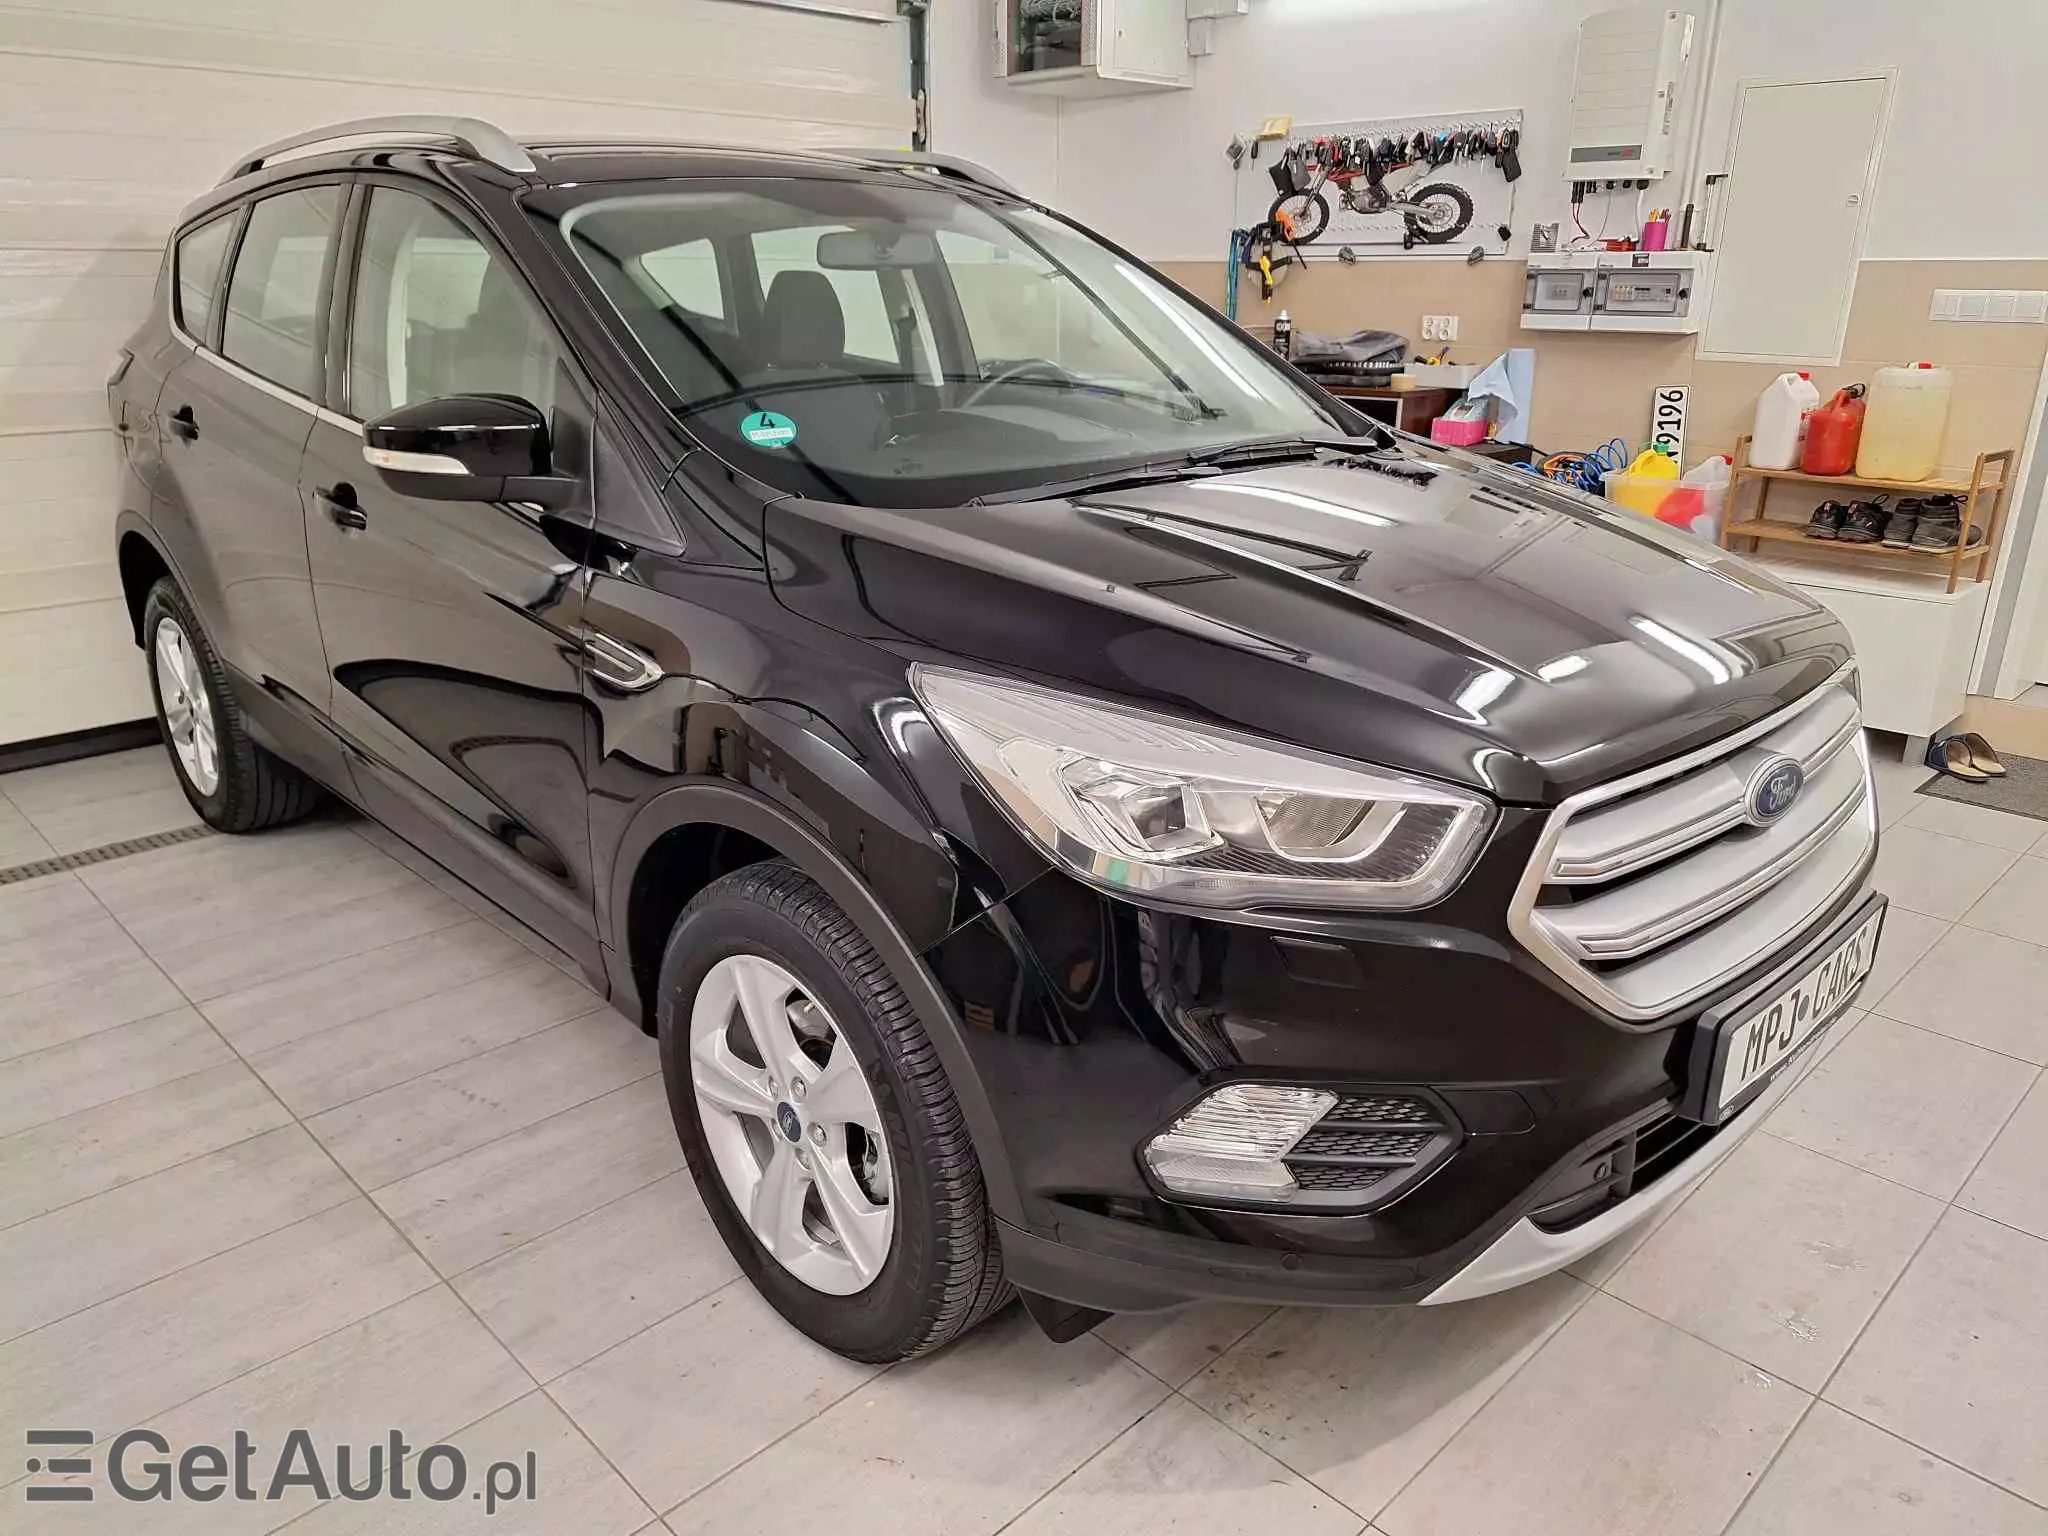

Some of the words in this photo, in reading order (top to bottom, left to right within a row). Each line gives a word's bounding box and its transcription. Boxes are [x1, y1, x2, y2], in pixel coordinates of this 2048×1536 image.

[760, 412, 776, 428] 4
[1769, 774, 1797, 811] Ford
[1741, 987, 1801, 1082] MPJ
[1812, 925, 1868, 1020] CARS
